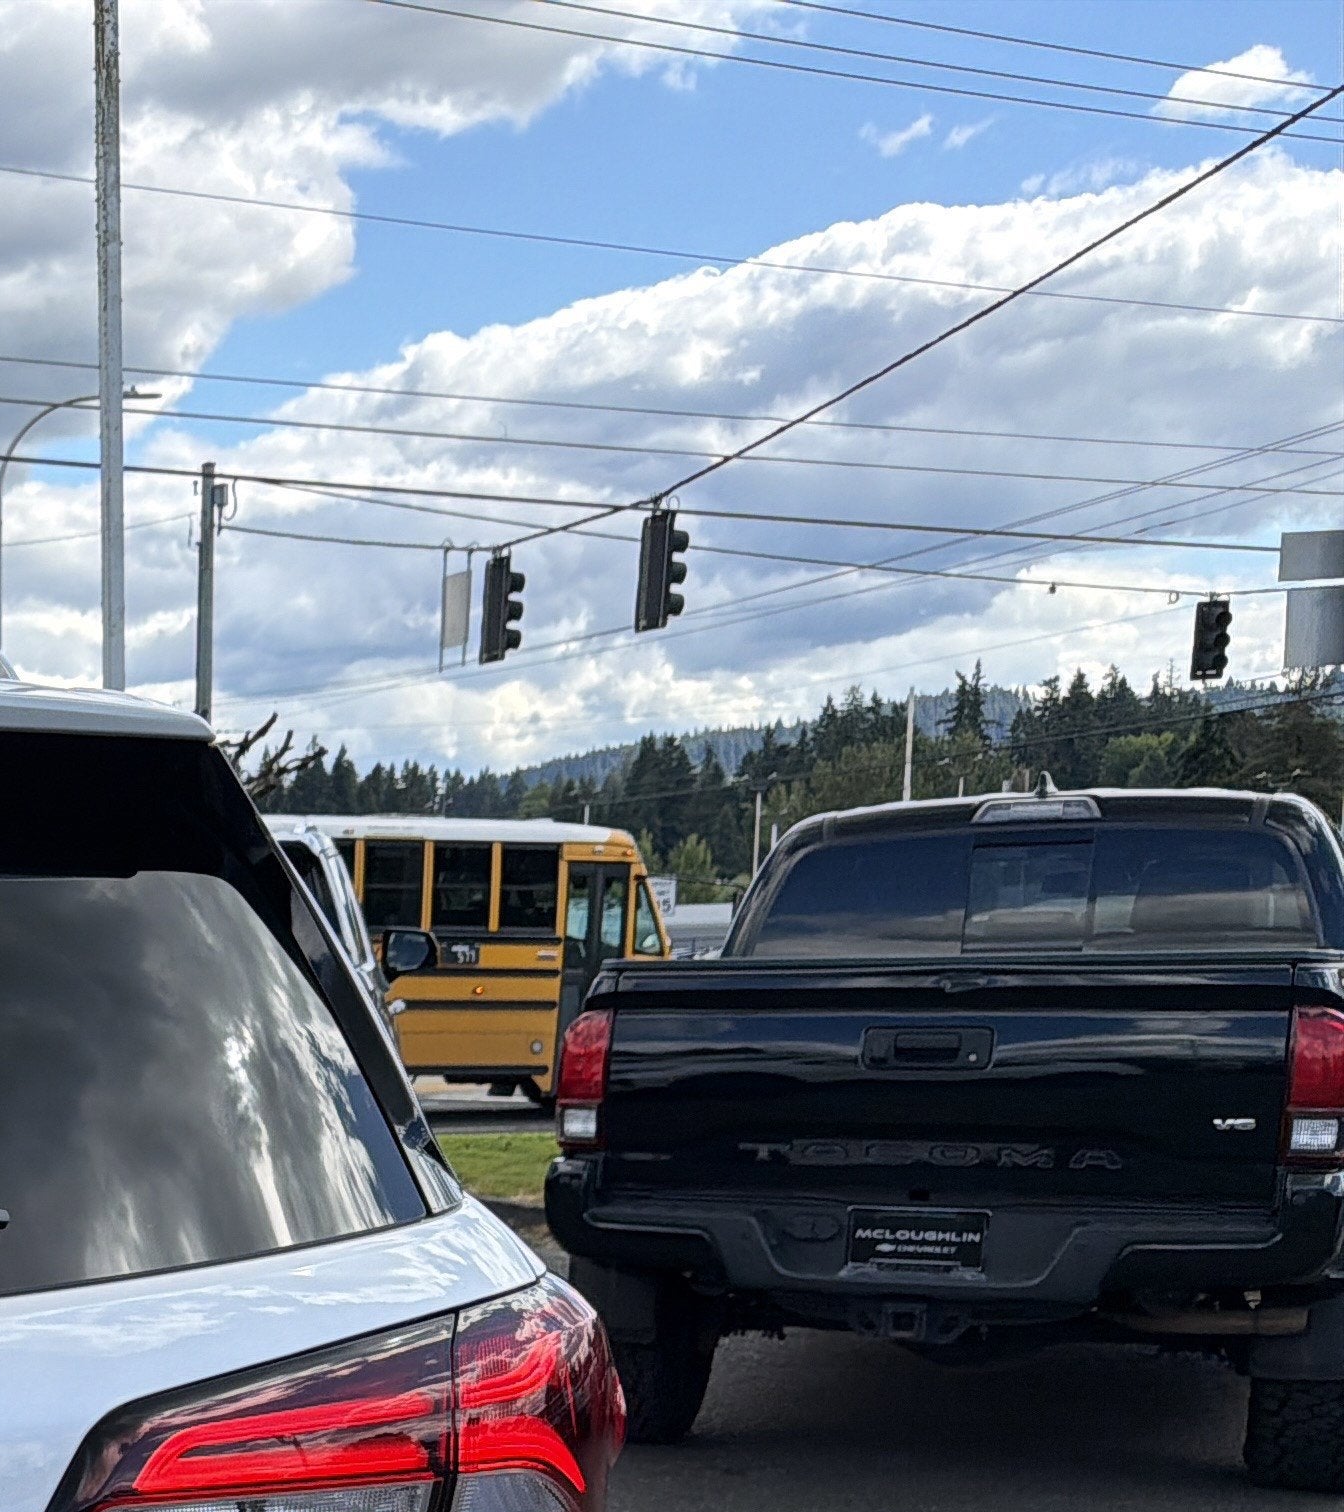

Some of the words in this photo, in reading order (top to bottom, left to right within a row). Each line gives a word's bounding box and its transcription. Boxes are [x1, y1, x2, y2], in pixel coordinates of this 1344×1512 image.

[1213, 1117, 1257, 1131] V6
[738, 1139, 1123, 1170] TACOMA
[854, 1228, 981, 1243] MCLOUGHLIN
